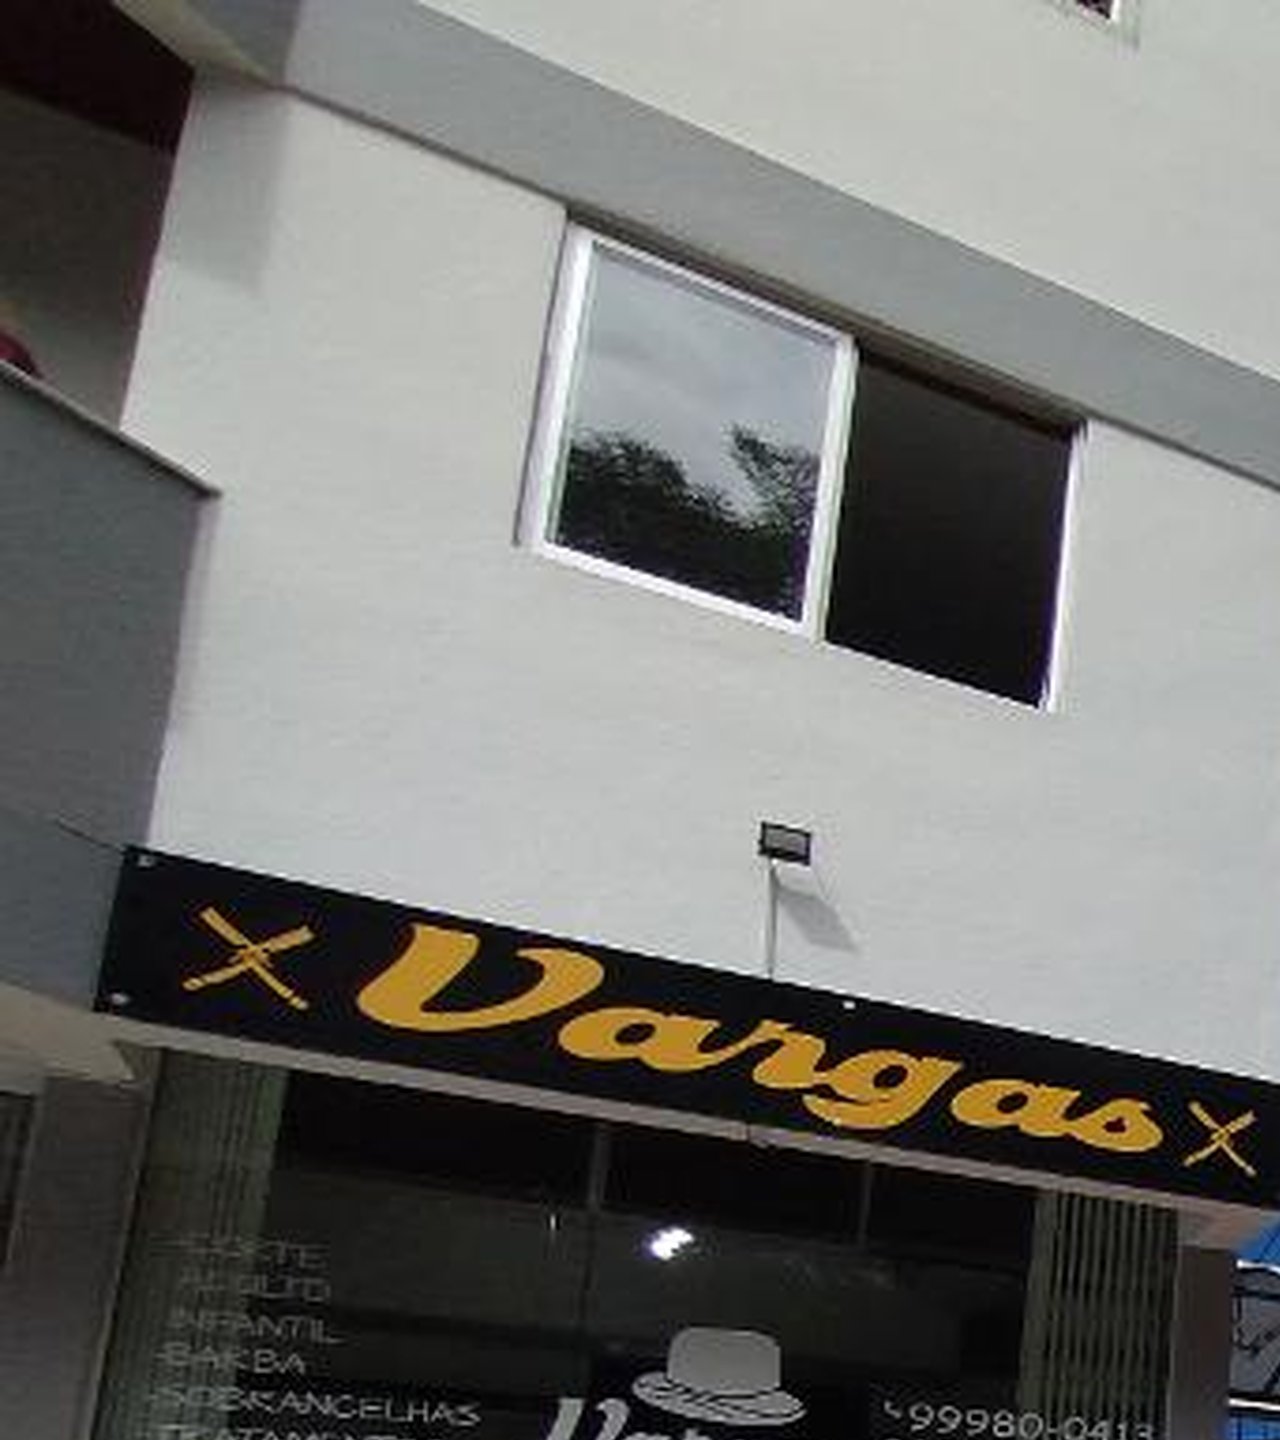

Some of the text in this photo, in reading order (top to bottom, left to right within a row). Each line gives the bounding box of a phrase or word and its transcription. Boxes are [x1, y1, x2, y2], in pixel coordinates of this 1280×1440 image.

[355, 923, 1166, 1155] Vargas
[158, 1342, 306, 1375] BARBA
[153, 1385, 482, 1428] SOBRANCELHAS
